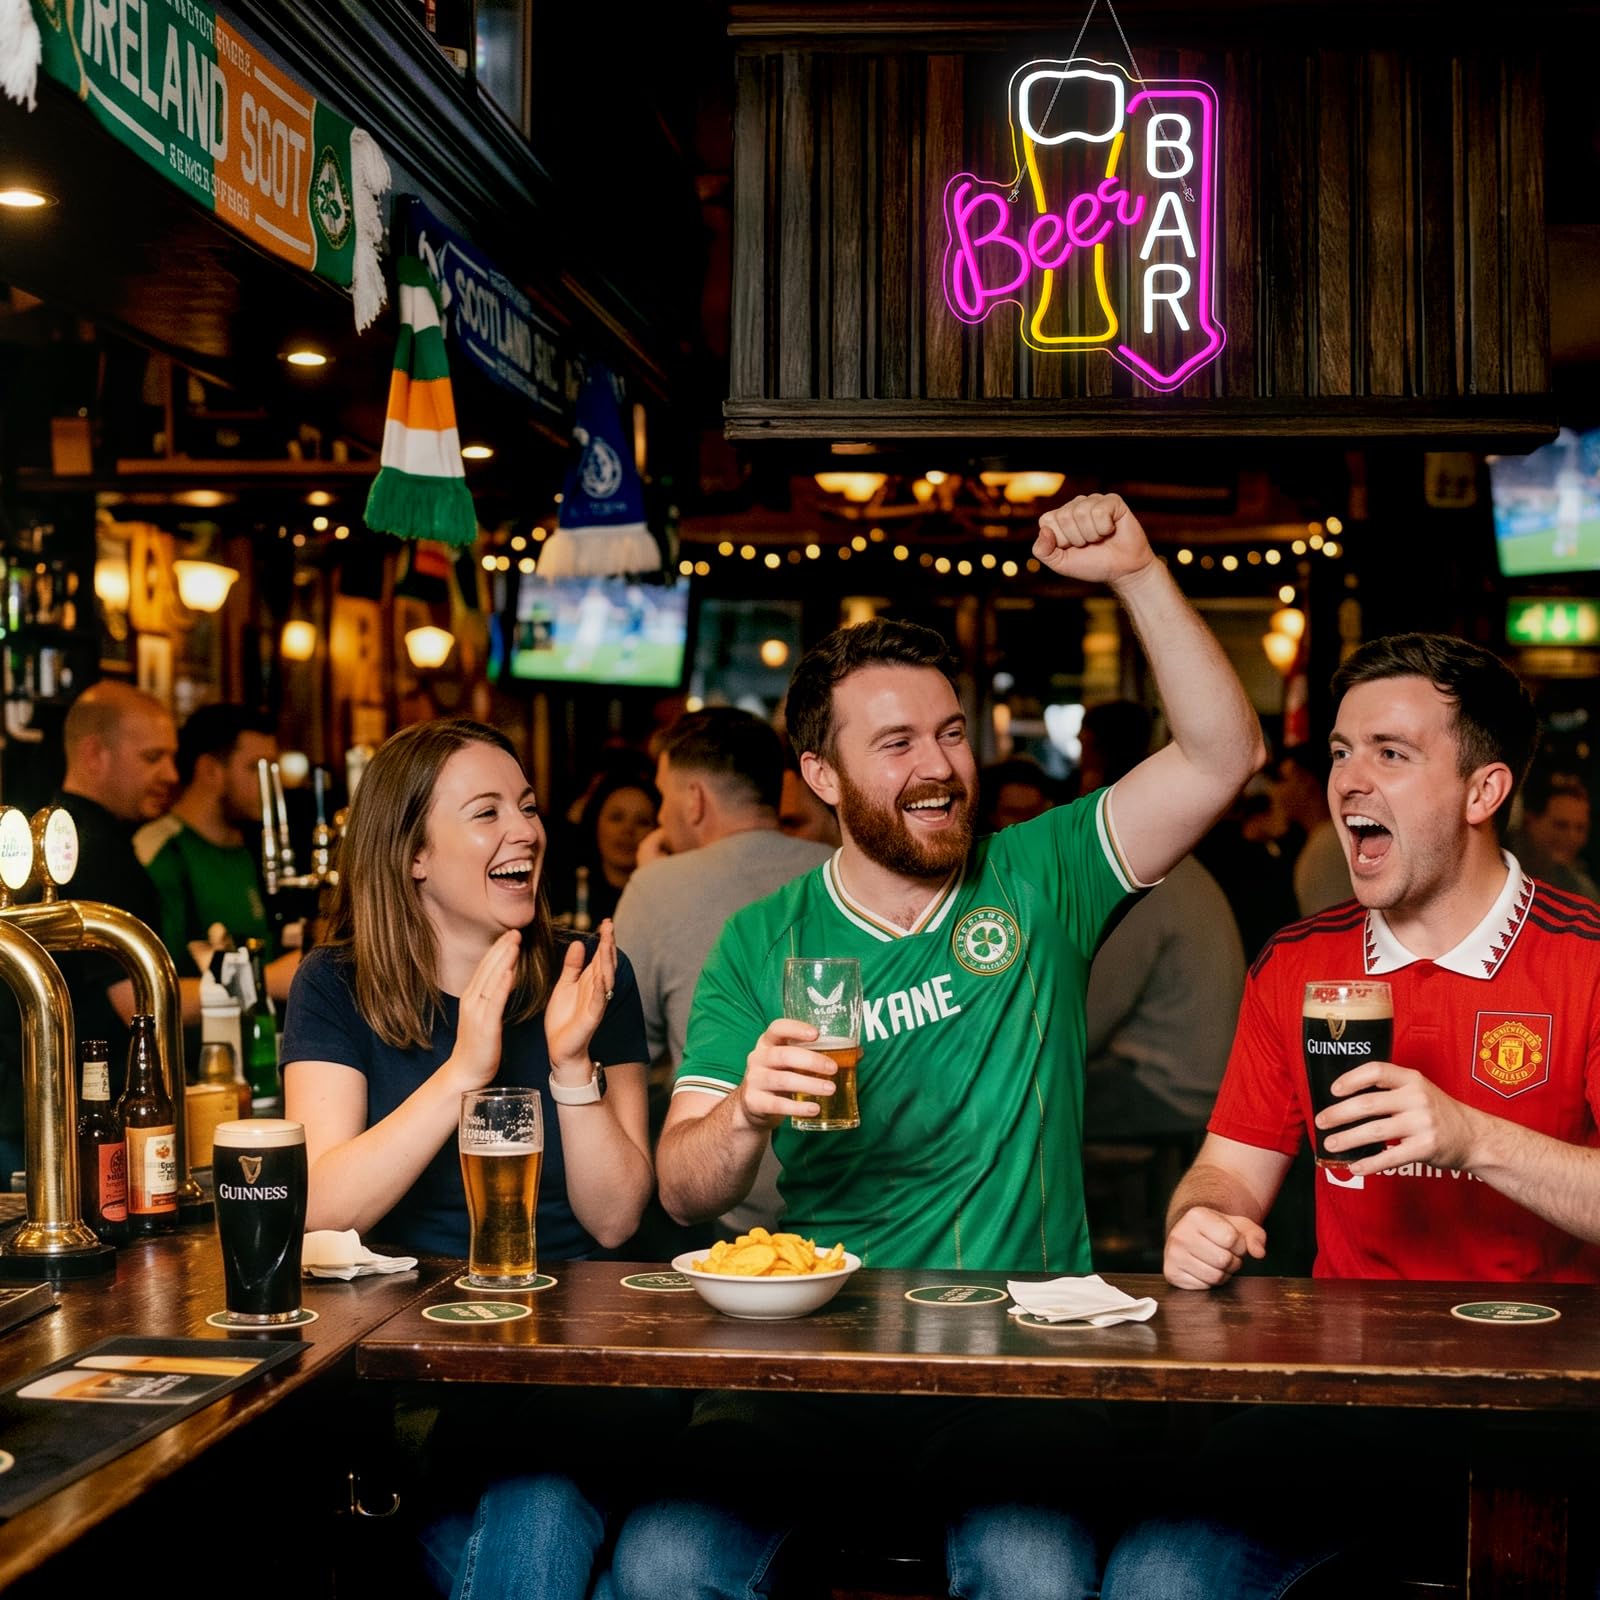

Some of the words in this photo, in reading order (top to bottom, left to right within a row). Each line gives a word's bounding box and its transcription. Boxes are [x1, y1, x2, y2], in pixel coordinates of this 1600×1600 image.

[81, 0, 229, 163] IRELAND
[240, 91, 306, 217] SCOT
[953, 177, 1146, 315] Beer
[1139, 113, 1196, 333] BAR
[454, 267, 534, 374] SCOTLAND
[863, 974, 961, 1042] KANE
